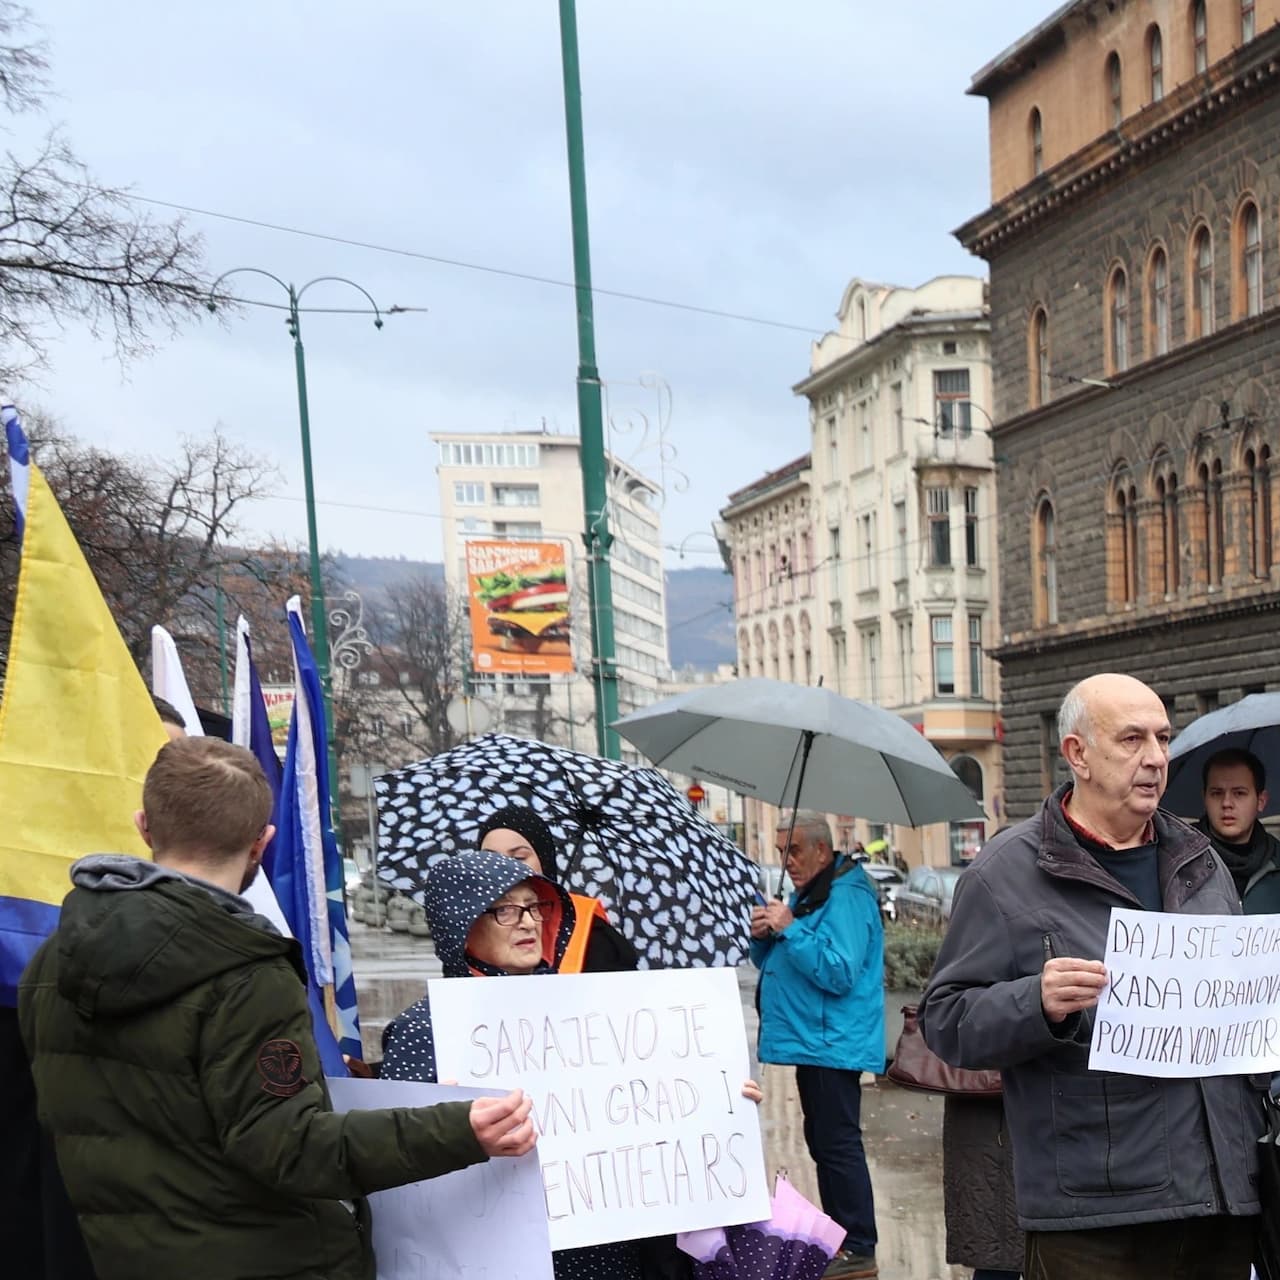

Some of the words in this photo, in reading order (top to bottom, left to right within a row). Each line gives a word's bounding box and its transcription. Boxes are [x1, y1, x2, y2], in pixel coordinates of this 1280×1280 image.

[1113, 919, 1144, 958] DA
[1151, 923, 1175, 960] LI
[1184, 924, 1228, 960] STE
[1107, 970, 1182, 1010] KADA
[469, 1007, 659, 1079] SARAJEVO
[667, 1002, 716, 1059] JE
[1096, 1019, 1182, 1065] POLITIKA
[1190, 1025, 1221, 1066] VODI
[1223, 1016, 1280, 1058] EUFOR
[531, 1087, 591, 1137] VNI
[604, 1076, 701, 1126] GRAD
[541, 1139, 694, 1222] ENTITETA
[701, 1131, 748, 1201] RS
